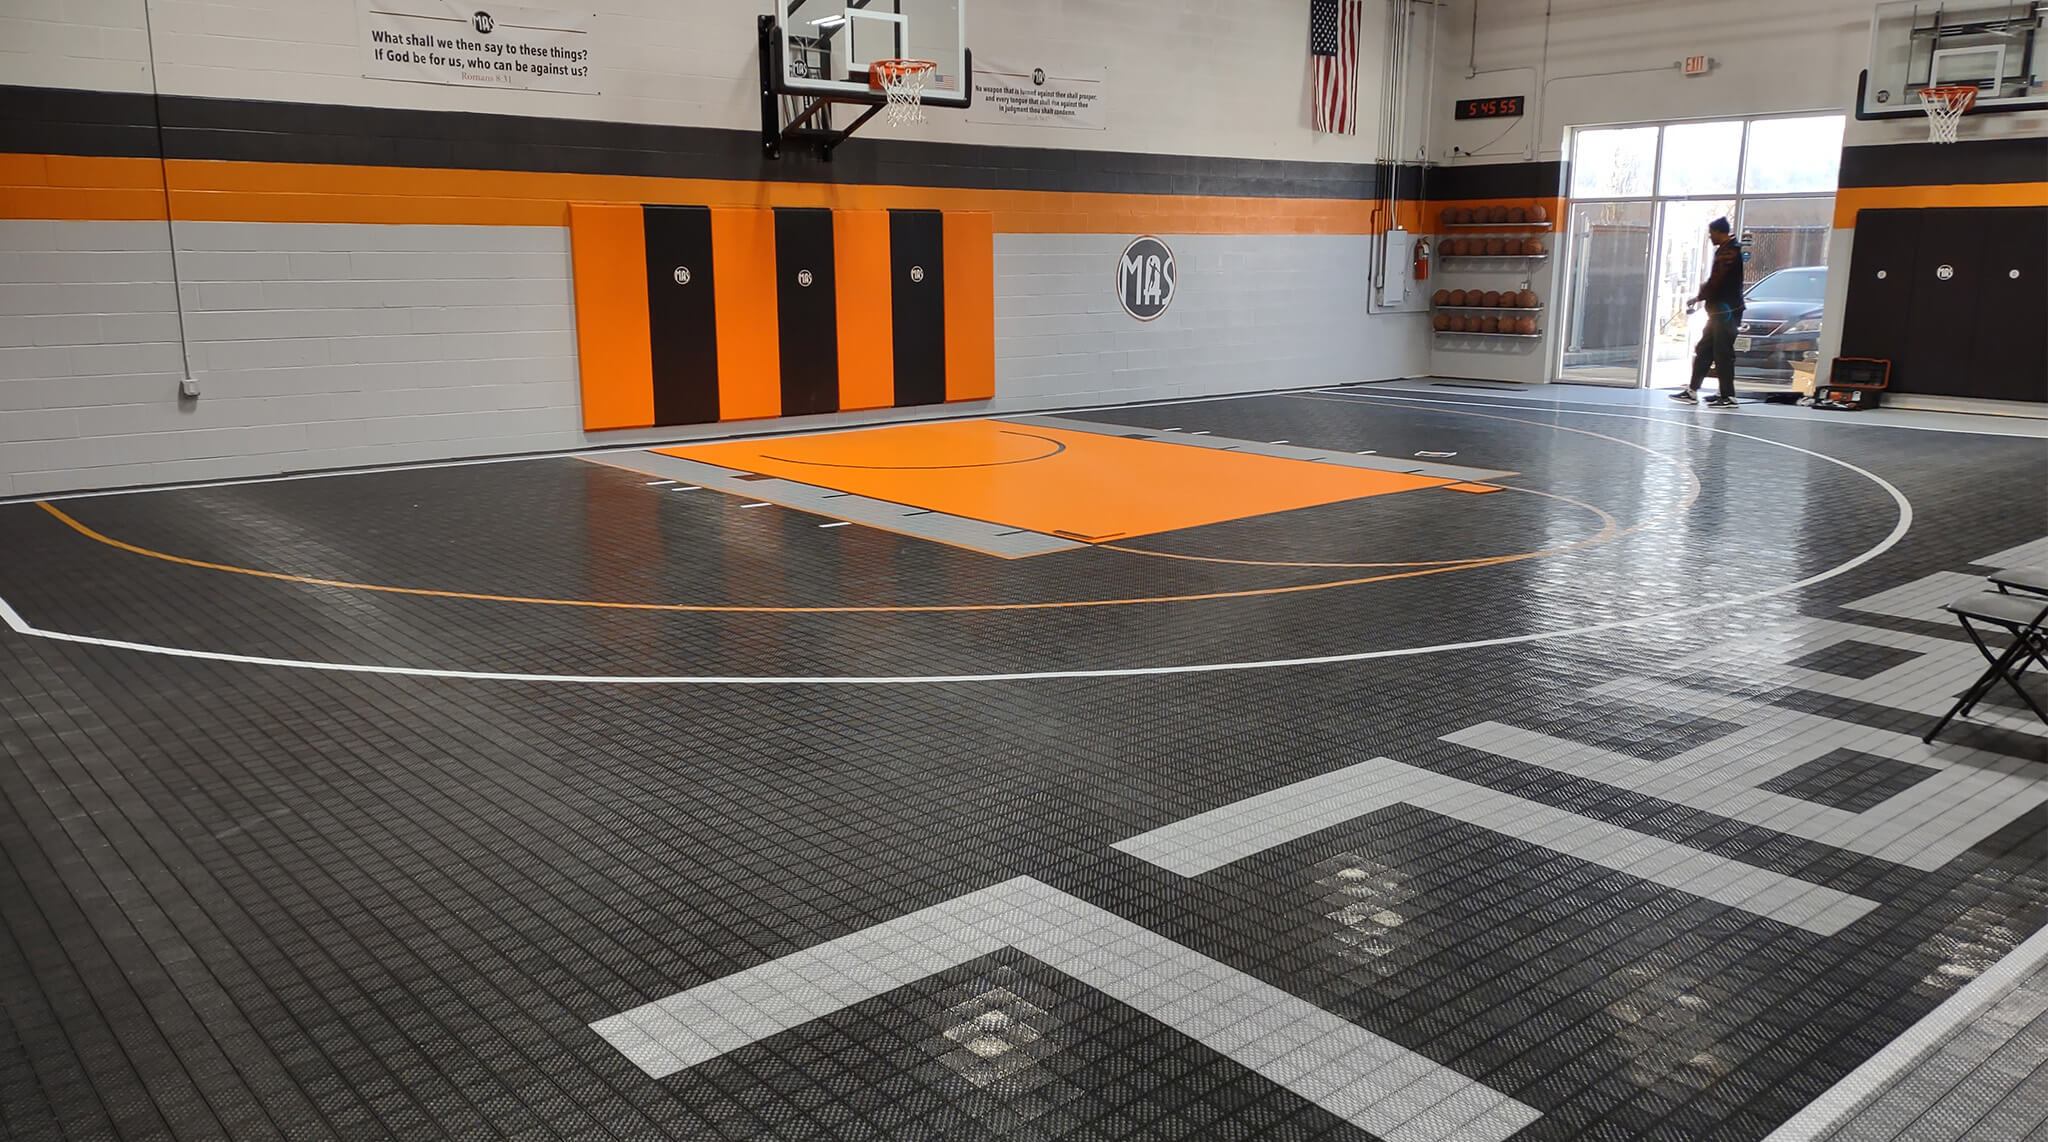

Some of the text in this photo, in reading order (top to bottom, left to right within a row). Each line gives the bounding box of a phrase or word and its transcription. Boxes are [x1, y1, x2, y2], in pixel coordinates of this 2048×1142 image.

[372, 30, 588, 62] What shall we then say to these things?
[375, 48, 588, 77] If God be for us, who can be against us?
[1686, 56, 1704, 72] EXIT
[462, 72, 493, 81] Romans
[1038, 90, 1054, 98] against
[1118, 251, 1175, 307] MAS
